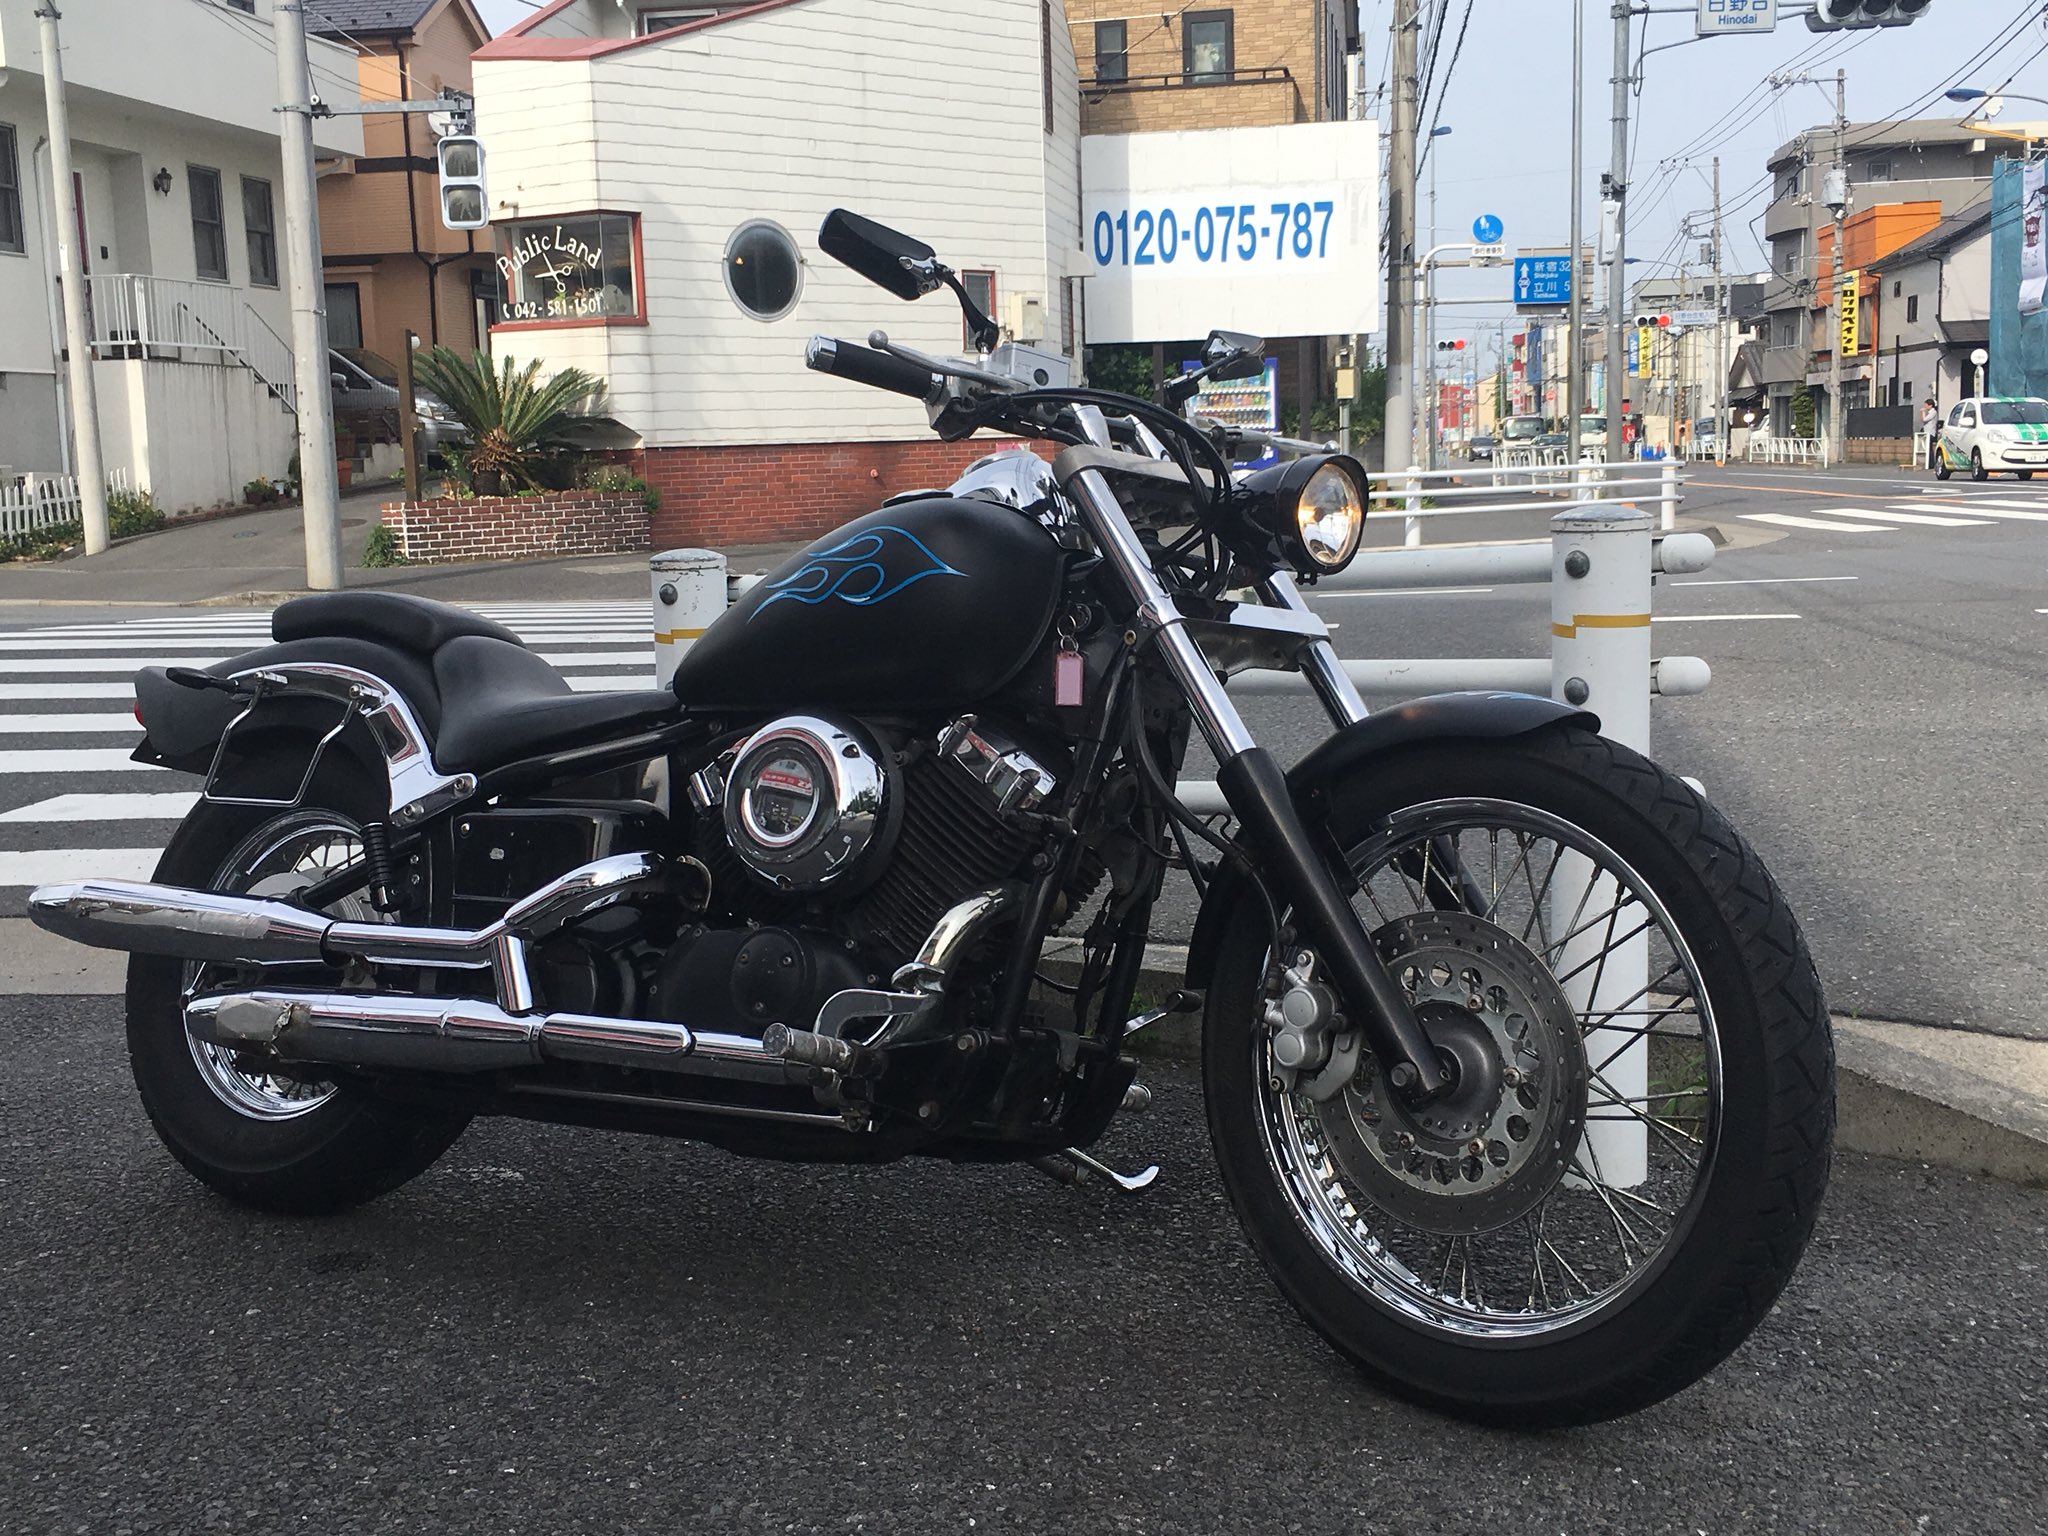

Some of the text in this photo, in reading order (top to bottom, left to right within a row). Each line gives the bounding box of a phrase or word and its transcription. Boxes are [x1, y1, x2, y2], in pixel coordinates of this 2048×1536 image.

[1718, 14, 1758, 25] Hinodai
[1093, 201, 1334, 266] 0120-075-787
[496, 225, 602, 281] Public Land
[1534, 260, 1571, 273] 新宿 32
[1533, 281, 1557, 293] 立川
[1842, 289, 1855, 354] ロックペイント
